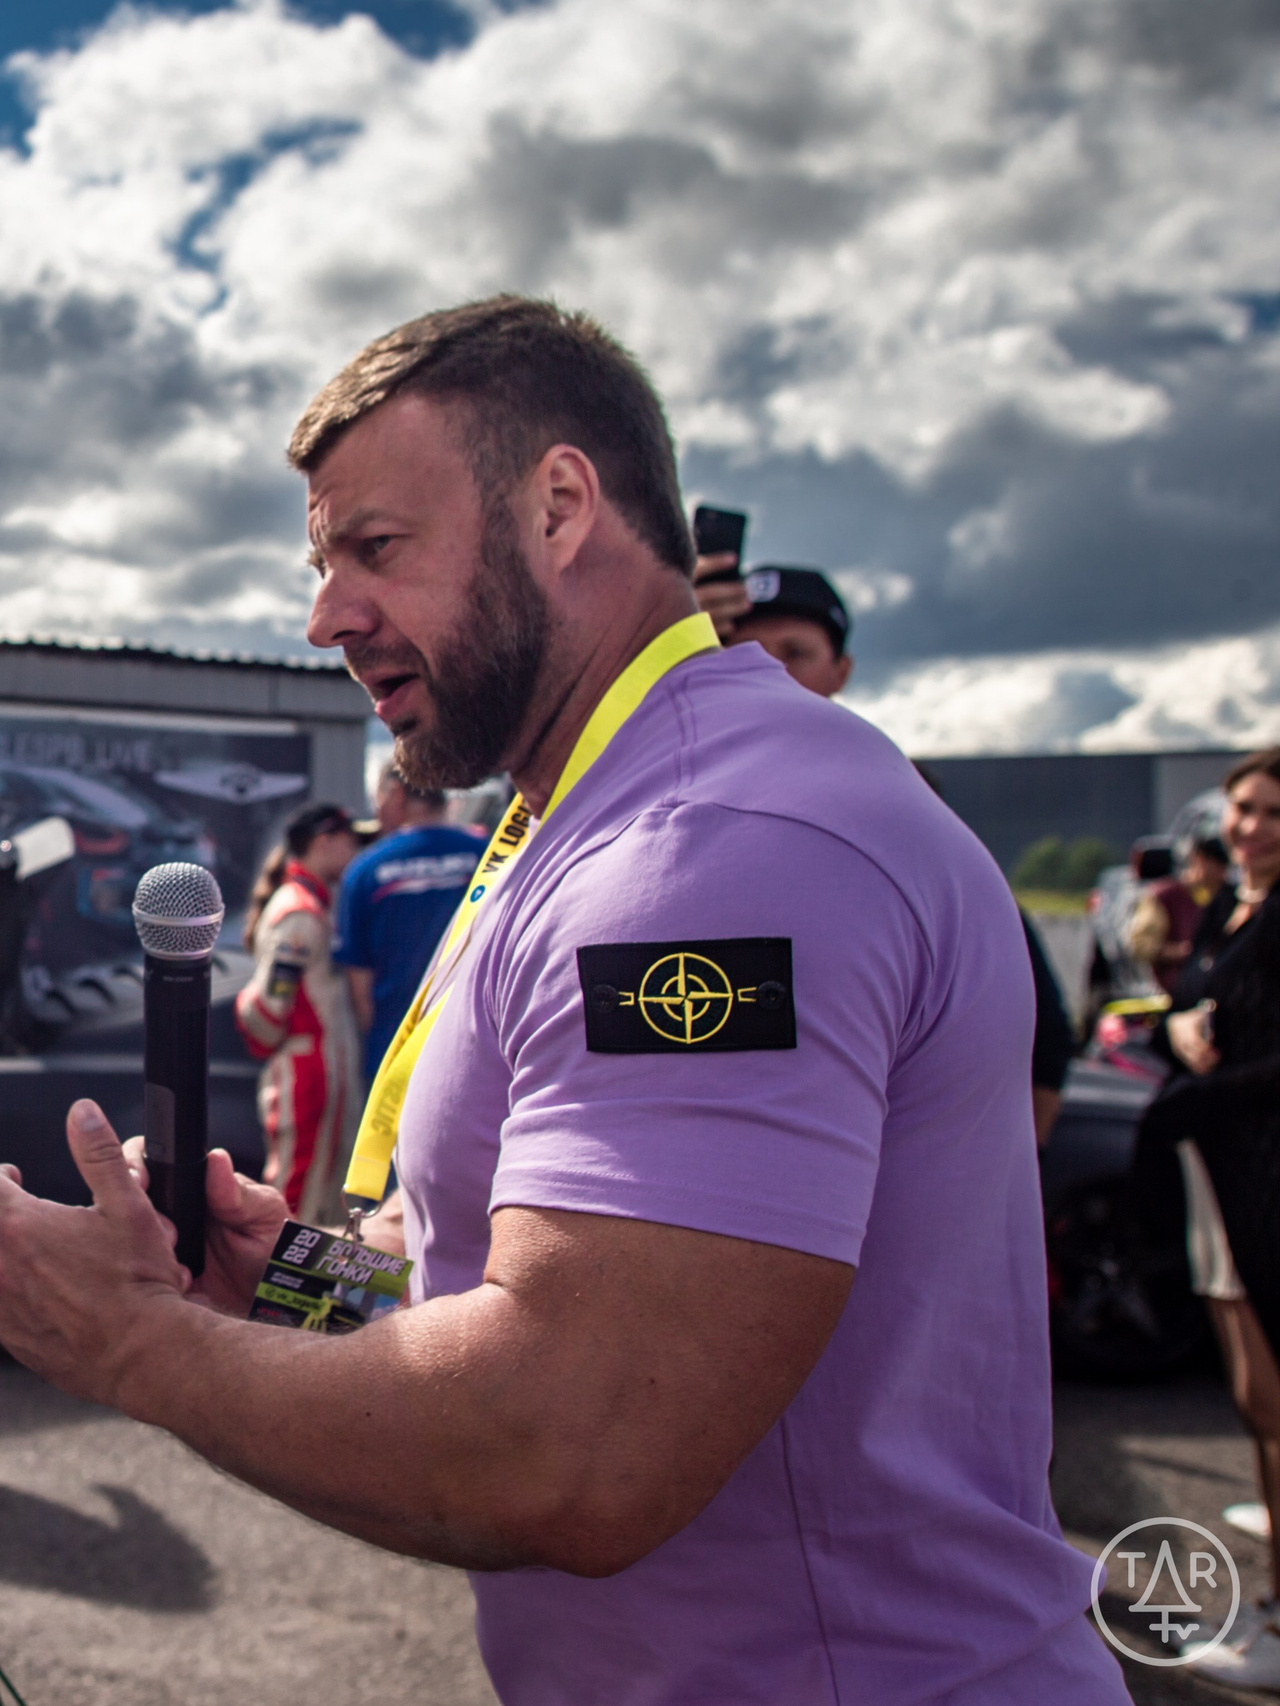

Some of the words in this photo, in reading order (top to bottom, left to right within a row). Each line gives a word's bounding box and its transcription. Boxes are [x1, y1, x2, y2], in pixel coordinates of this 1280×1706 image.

[293, 1229, 321, 1249] 20
[282, 1244, 310, 1265] 22
[327, 1239, 406, 1276] БОЛЬШИЕ
[316, 1256, 374, 1285] ГОНКИ
